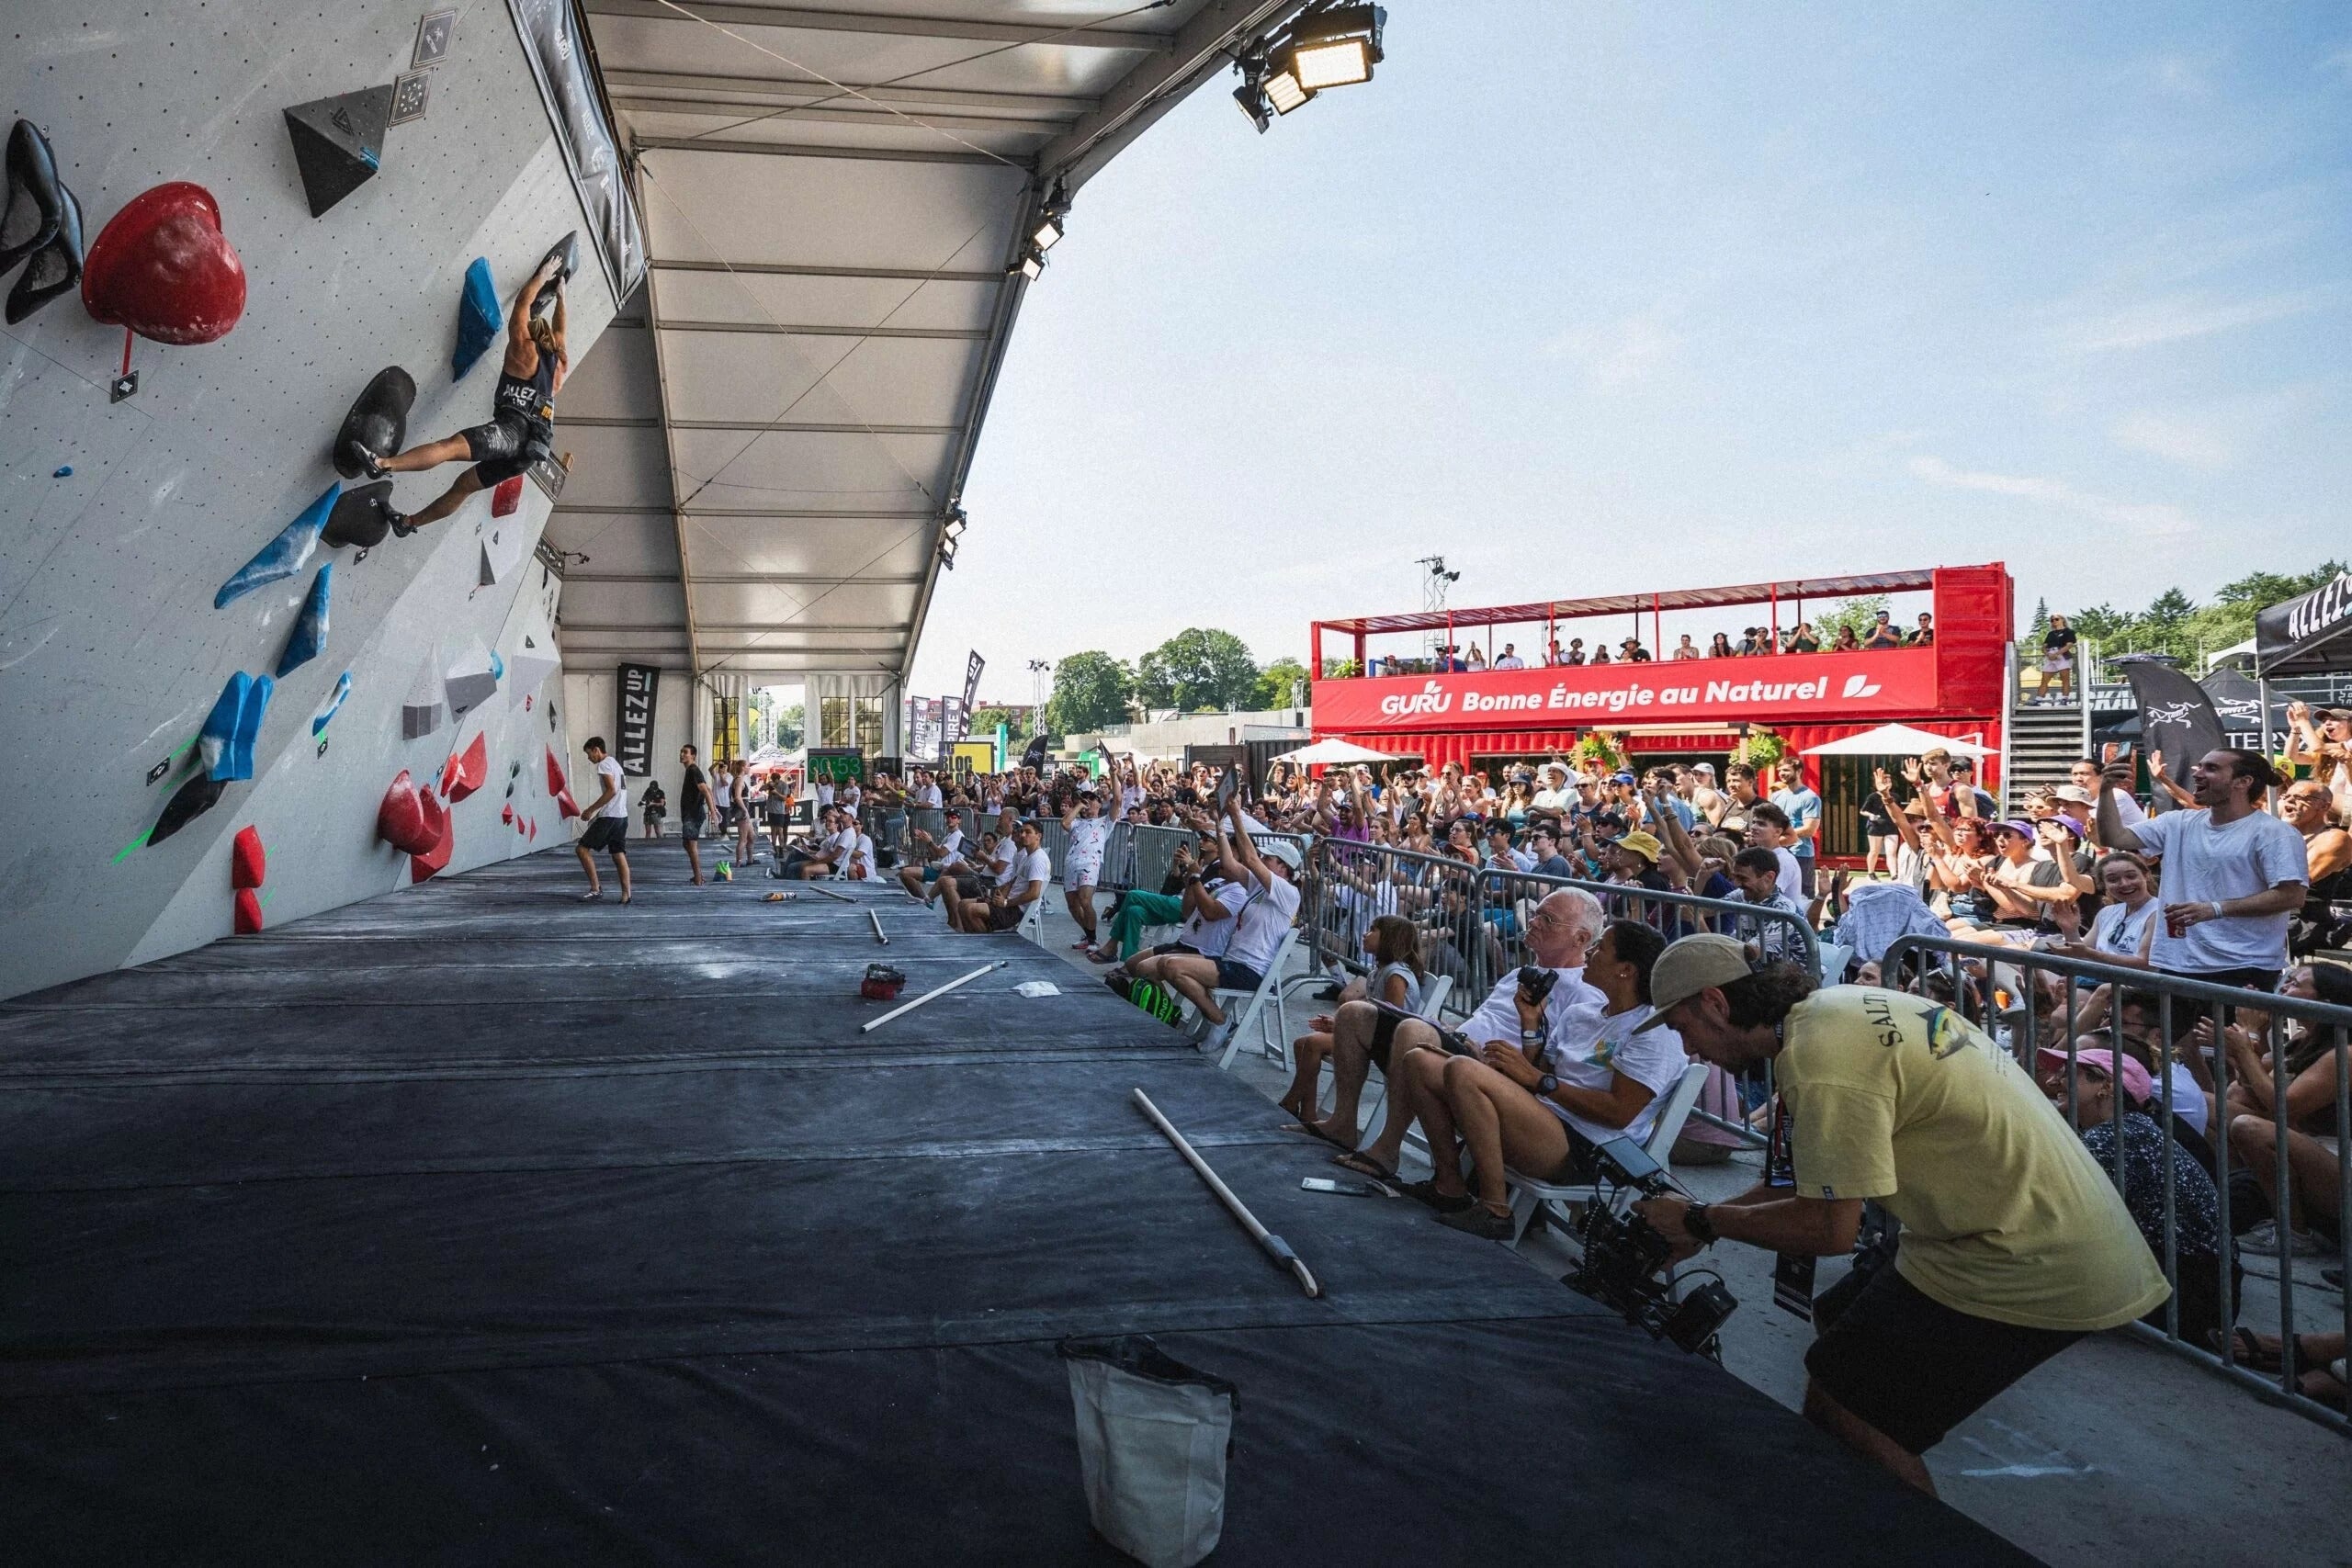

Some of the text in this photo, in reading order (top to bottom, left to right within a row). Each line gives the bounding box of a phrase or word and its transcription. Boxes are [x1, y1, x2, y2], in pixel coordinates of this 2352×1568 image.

[503, 384, 537, 400] ALLEZ
[2289, 577, 2347, 642] ALLEZ
[968, 657, 978, 678] UP
[1381, 676, 1828, 715] GURU Bonne Énergie au Naturel
[624, 669, 649, 773] ALLEZ UP
[809, 757, 861, 774] 00:53
